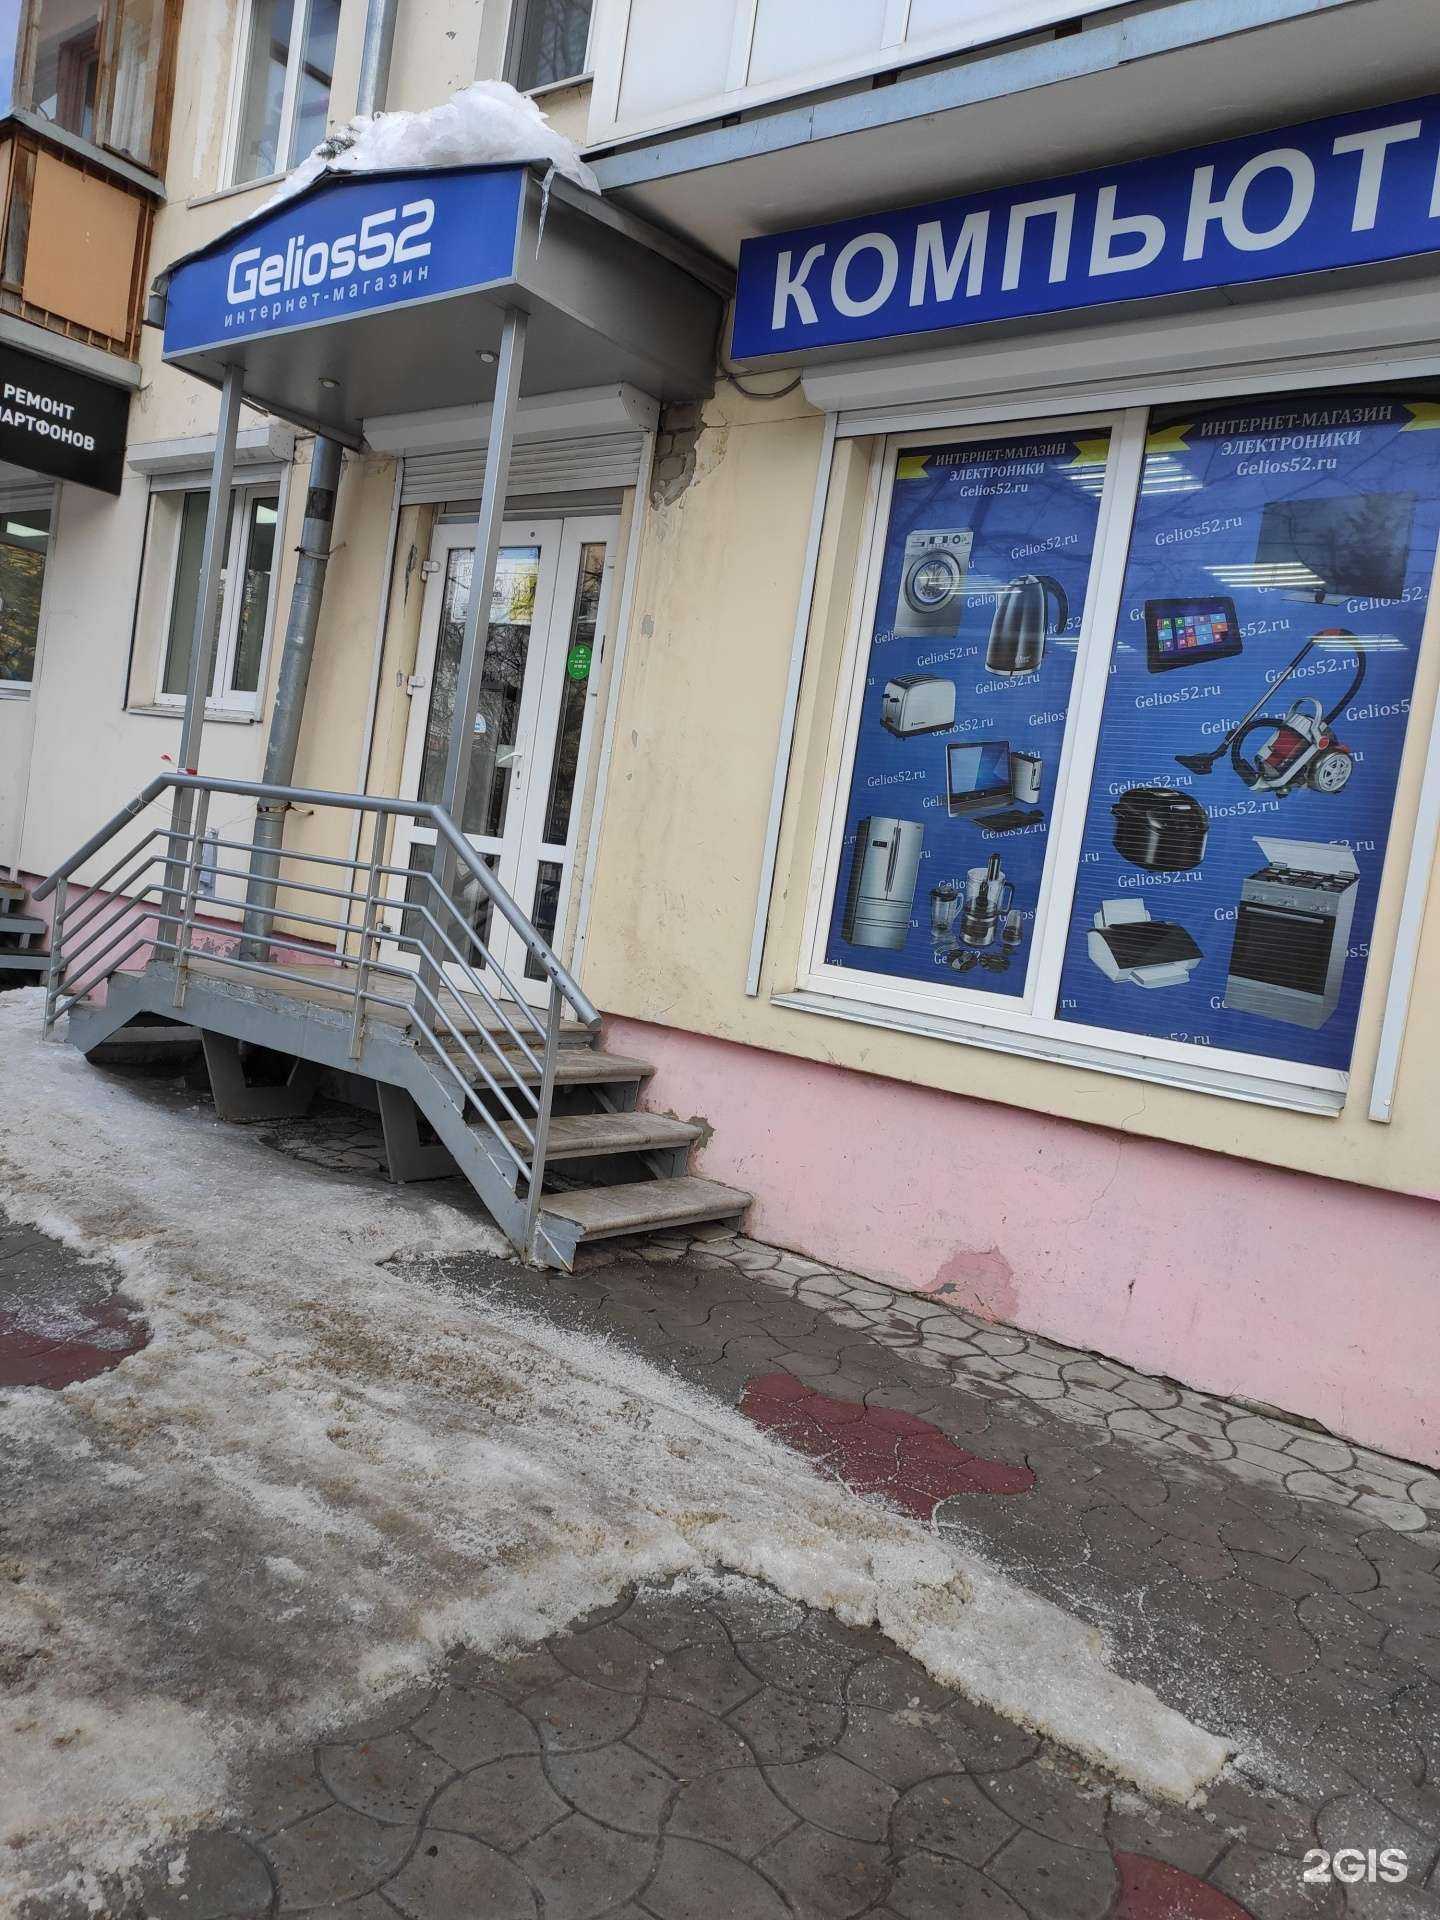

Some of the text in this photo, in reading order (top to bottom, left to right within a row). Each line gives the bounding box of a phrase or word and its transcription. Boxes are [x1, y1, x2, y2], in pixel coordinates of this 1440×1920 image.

[771, 119, 1440, 331] КОМПЬЮТ
[226, 198, 435, 305] Gelios52
[224, 265, 429, 328] интернет-магазин
[3, 383, 75, 420] РЕМОНТ
[0, 405, 95, 451] АРТФОНОВ
[1200, 405, 1393, 436] ИНТЕРНЕТ-МАГАЗИН
[935, 442, 1067, 466] ИНТЕРНЕТ-МАГАЗИН
[1220, 430, 1361, 456] ЭЛЕКТРОНИКИ
[949, 462, 1045, 481] ЭЛЕКТРОНИКИ
[1236, 456, 1337, 476] Gelios52.ru
[959, 482, 1029, 497] Gelios52.ru
[1154, 515, 1243, 546] Gelios52.ru
[1011, 533, 1079, 560] Gelios52.ru
[1239, 618, 1290, 637] s52.ru
[917, 646, 978, 667] Gelios52.ru
[1265, 657, 1360, 683] Gios52.ru
[1135, 685, 1221, 709] Gelios52.ru
[1028, 708, 1068, 727] Gelios
[1346, 699, 1410, 721] Gelios5
[867, 770, 926, 787] Gelios52.ru
[1205, 800, 1280, 819] lios52.ru
[1118, 870, 1204, 888] Gelios52.ru
